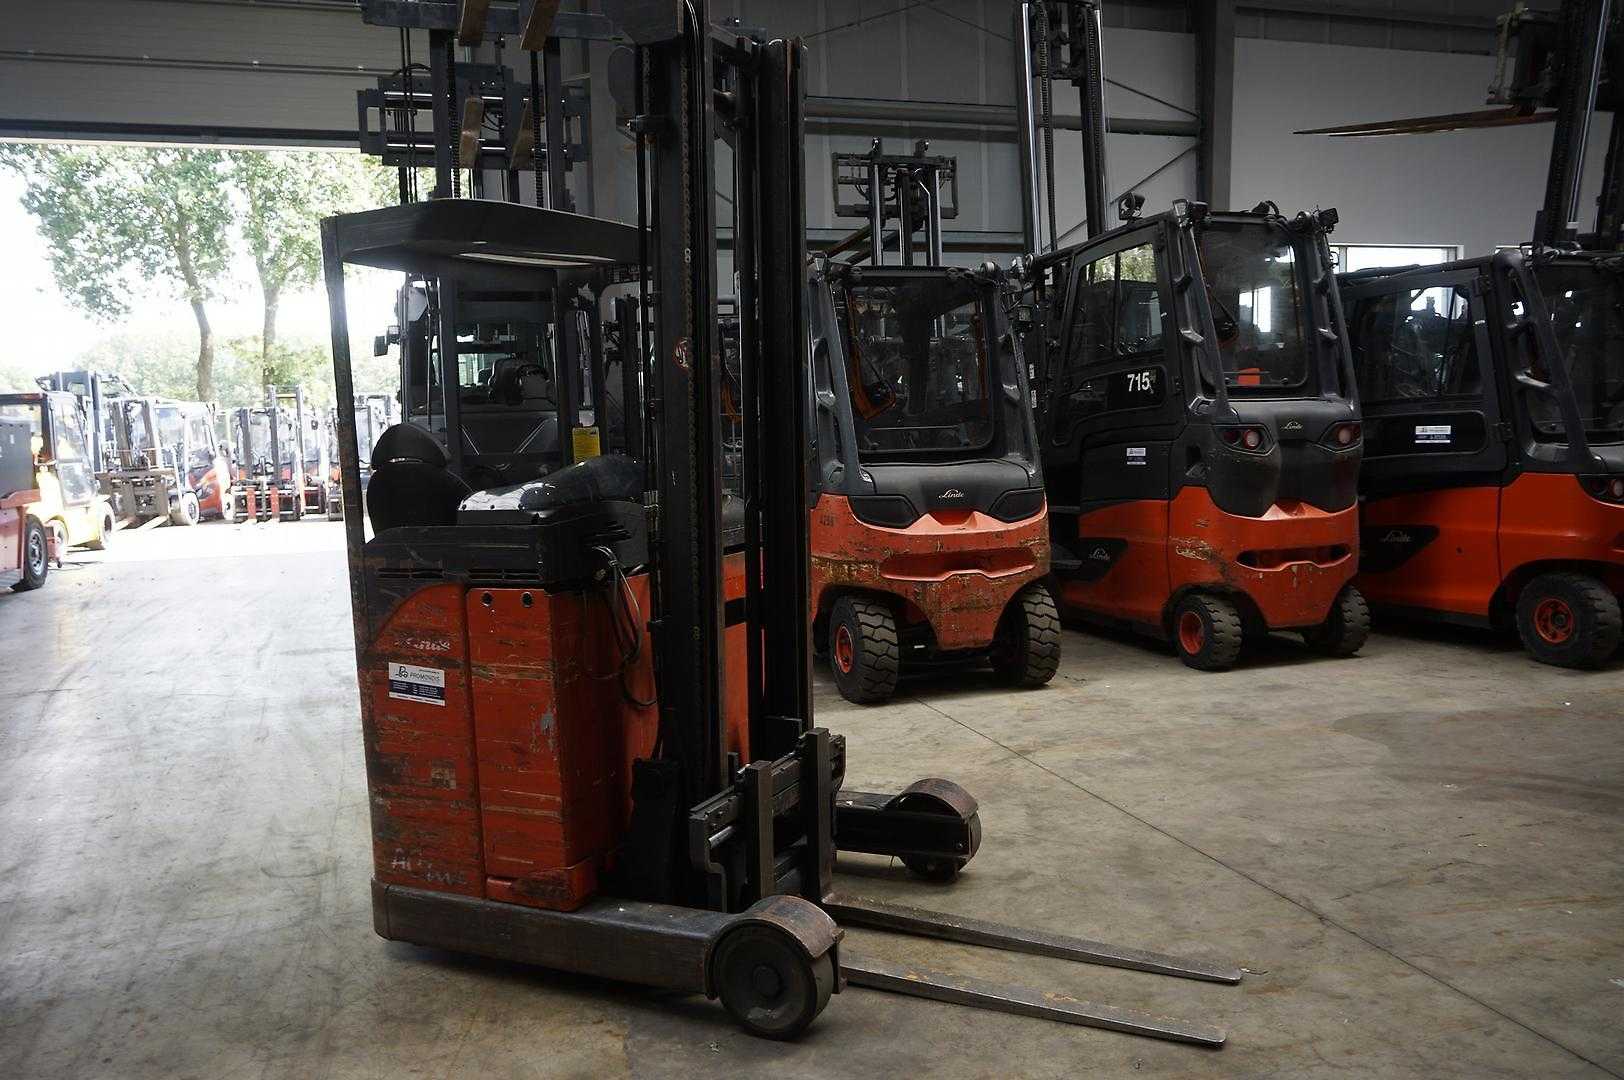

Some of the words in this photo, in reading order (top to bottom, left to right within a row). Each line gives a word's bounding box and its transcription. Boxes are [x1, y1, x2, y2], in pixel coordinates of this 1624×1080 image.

[1127, 372, 1150, 392] 715
[938, 489, 965, 499] Linde
[1379, 530, 1413, 543] Linde
